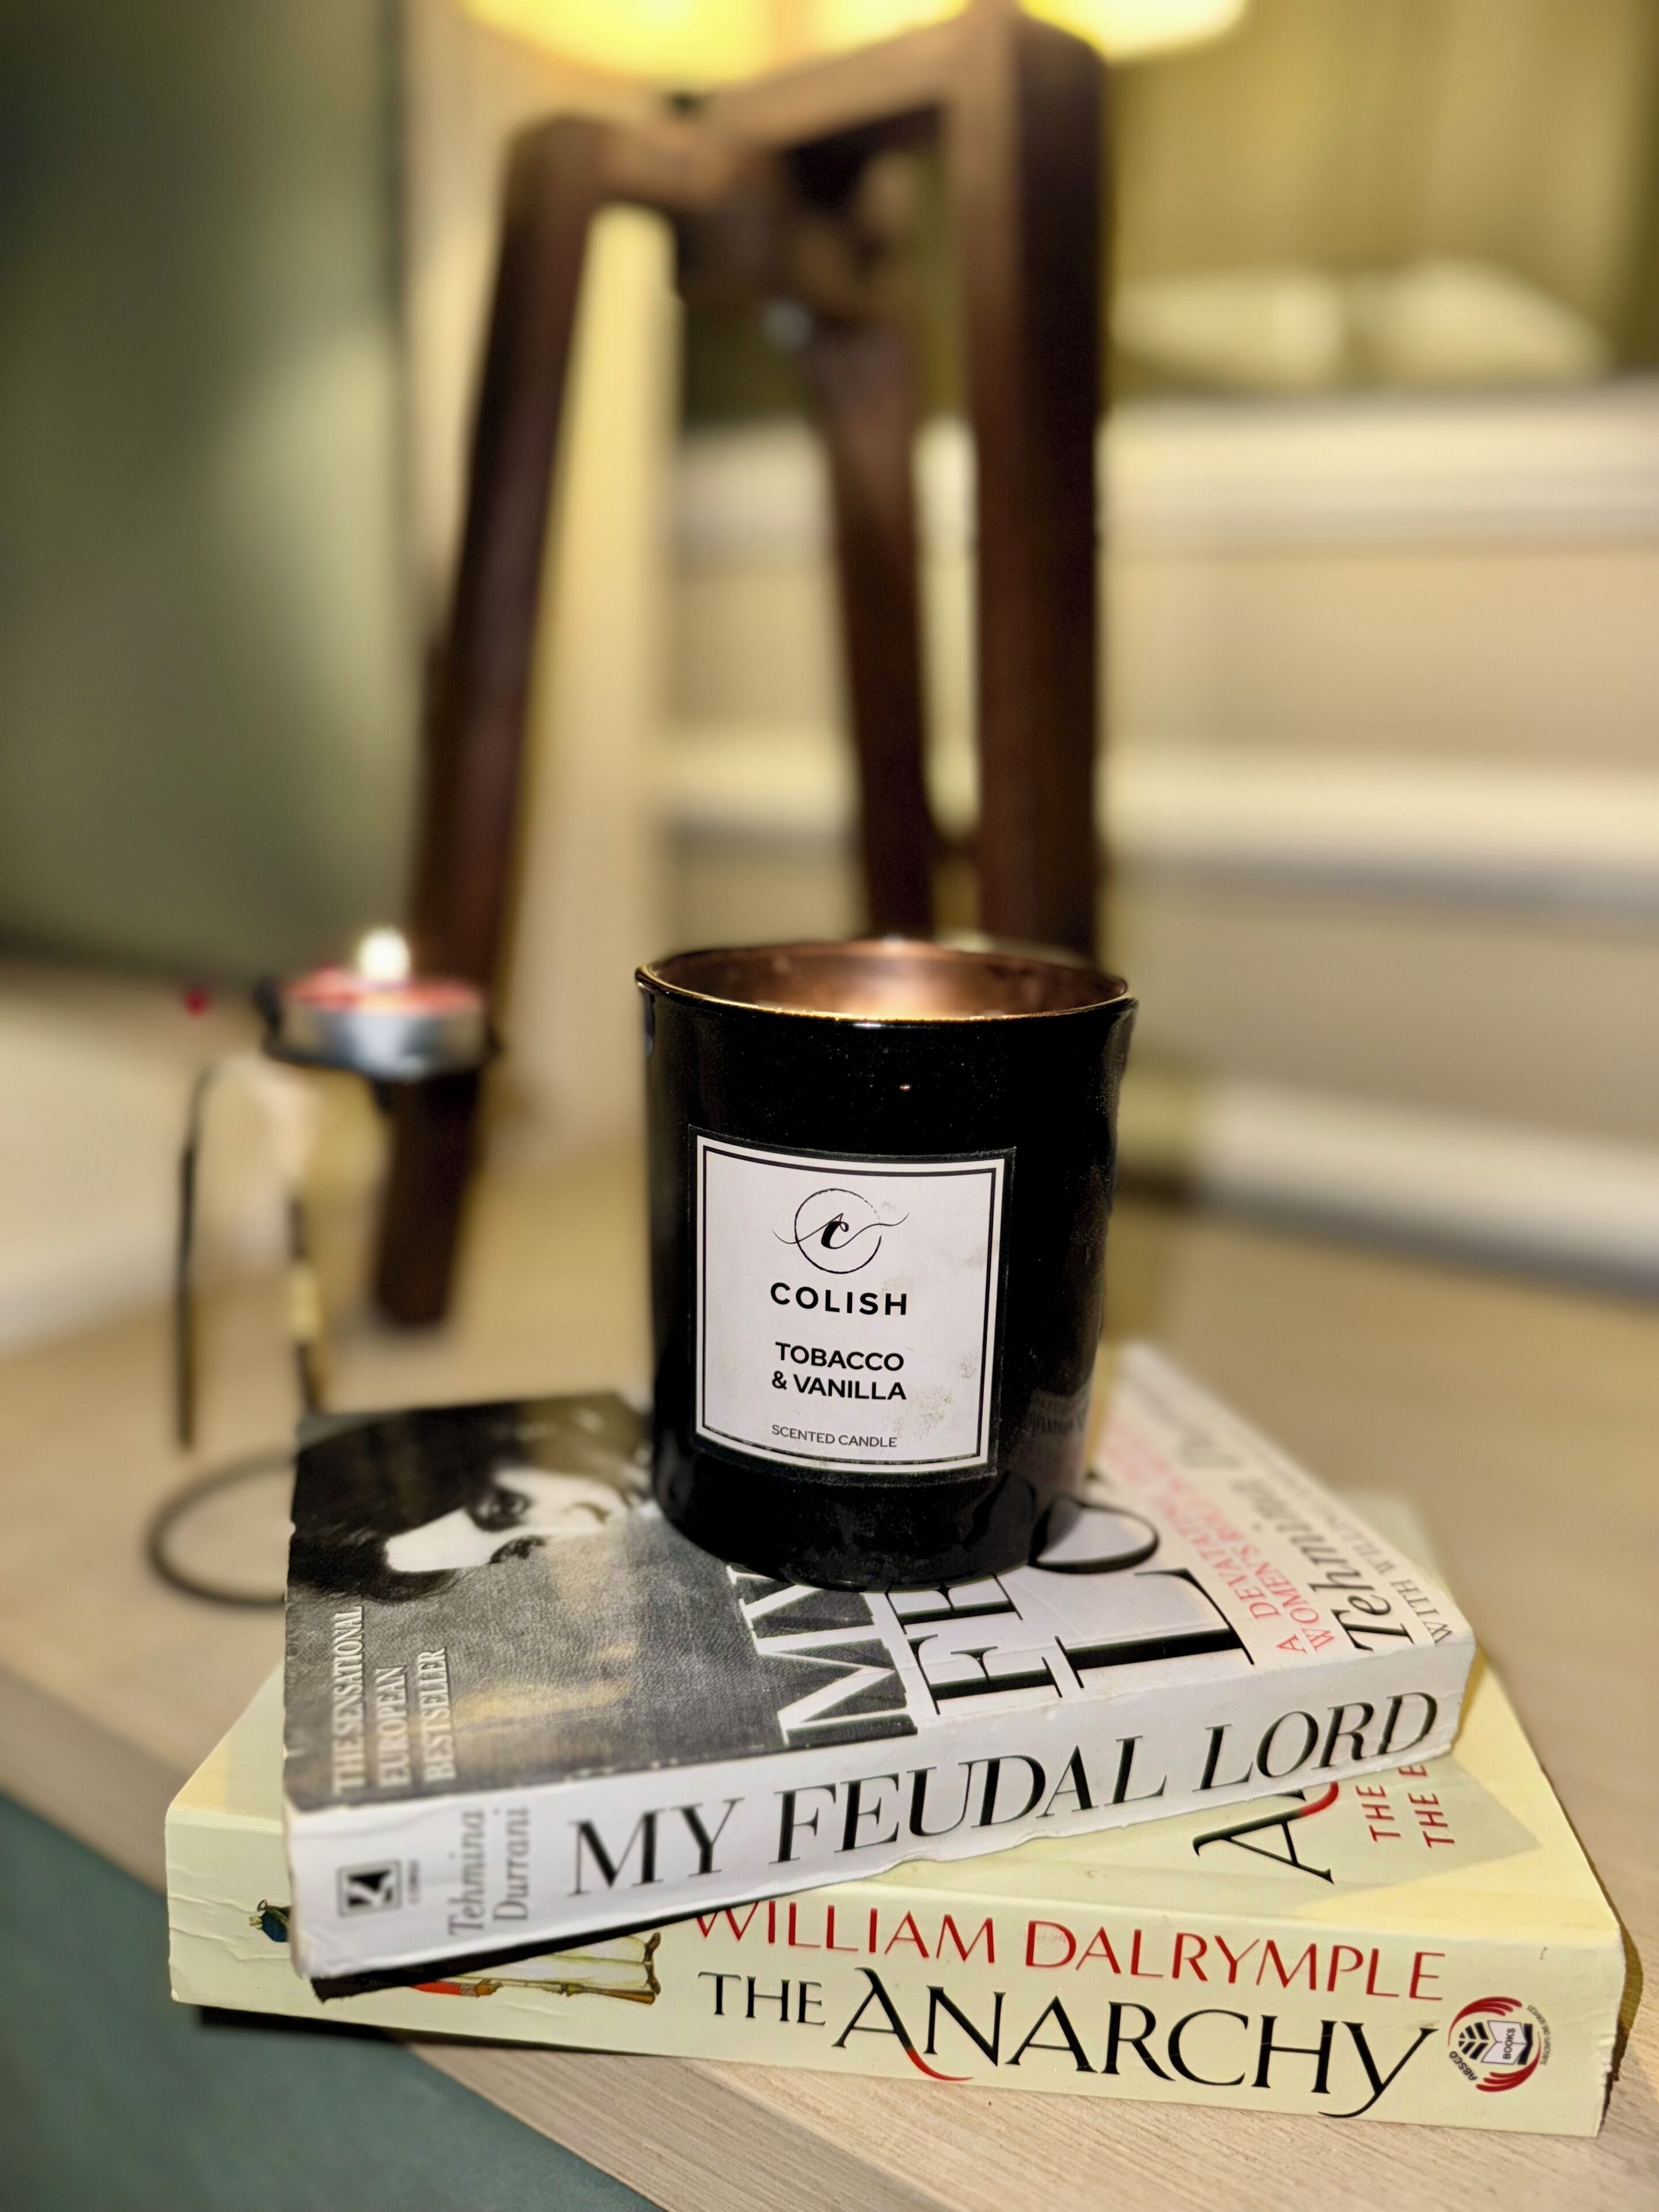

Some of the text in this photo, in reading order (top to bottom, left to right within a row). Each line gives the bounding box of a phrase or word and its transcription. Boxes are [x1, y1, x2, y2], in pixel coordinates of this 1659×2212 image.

[770, 1282, 907, 1315] COLISH
[772, 1371, 907, 1400] & VANILLA
[775, 1342, 904, 1371] TOBACCO
[772, 1425, 897, 1448] SCENTED CANDLE
[1390, 1579, 1453, 1646] WITH
[1275, 1634, 1306, 1654] A
[333, 1606, 367, 1795] THE SENSATIONAL
[376, 1666, 411, 1786] EUROPEAN
[417, 1647, 456, 1782] BESTSELLER
[567, 1797, 744, 1896] MY
[769, 1735, 1167, 1866] FEUDAL
[1192, 1691, 1437, 1793] LORD
[1355, 1785, 1401, 1842] THE
[1407, 1793, 1456, 1849] THE
[448, 1809, 485, 1937] Tehmina
[494, 1808, 529, 1922] Durrani
[696, 1900, 1445, 2002] WILLIAM DALRYMPLE
[698, 1967, 1438, 2118] THE ANARCHY
[1449, 2051, 1477, 2081] ABSCO
[1503, 2028, 1516, 2060] BOOKS
